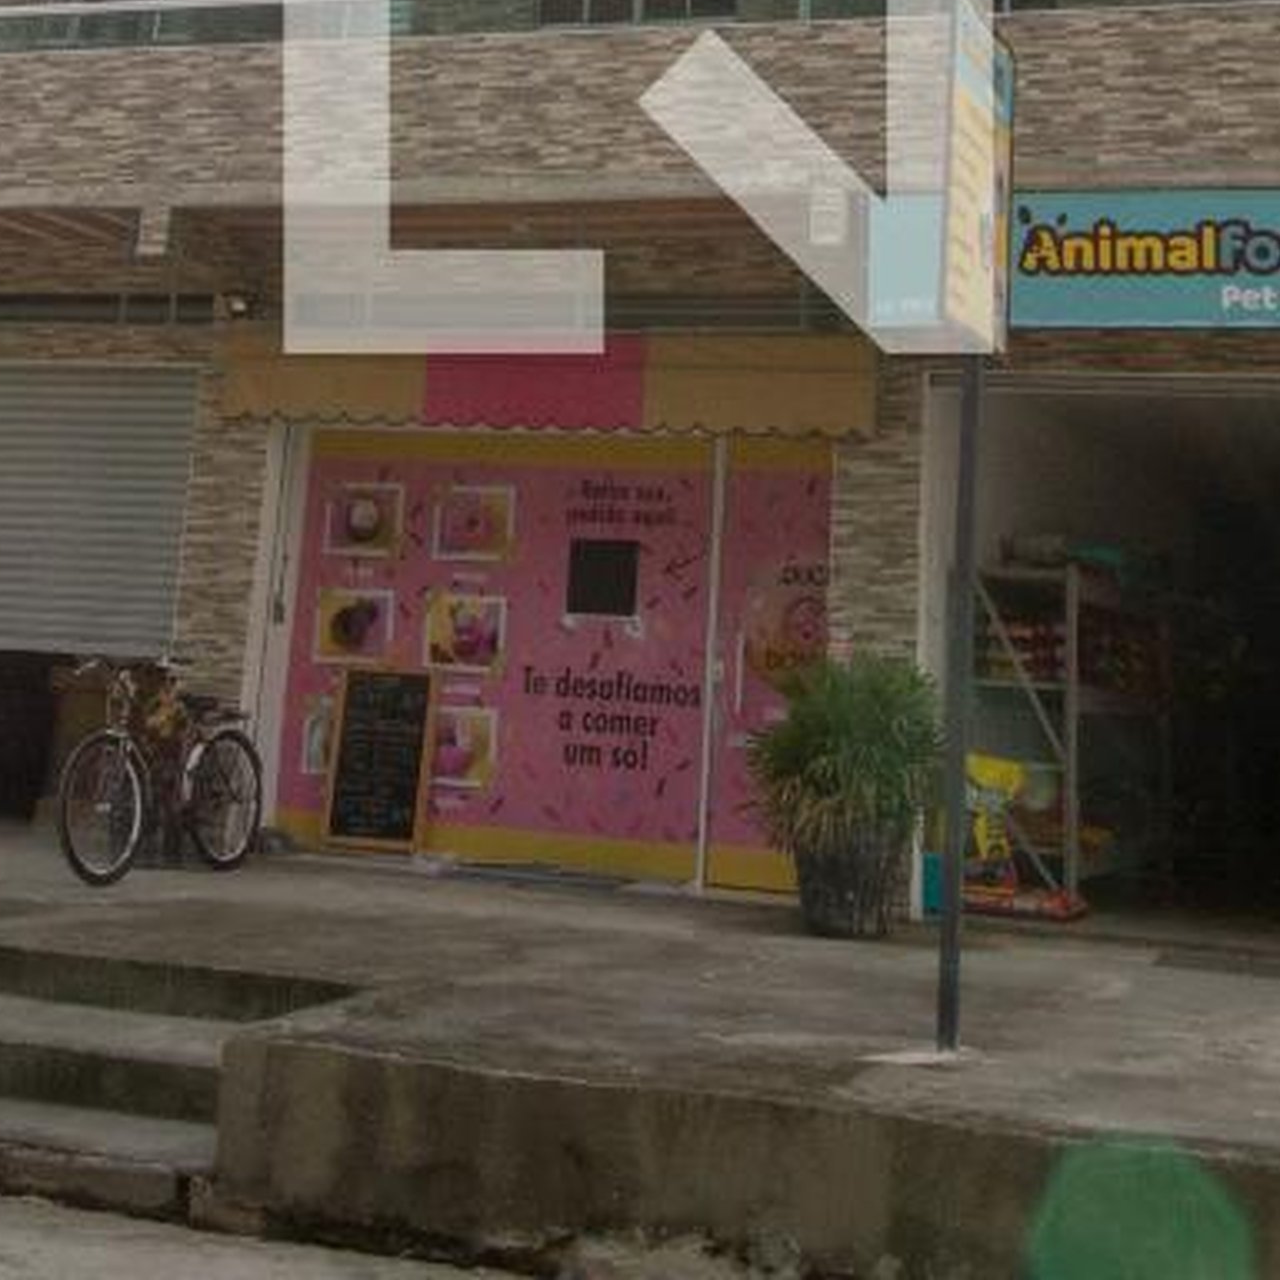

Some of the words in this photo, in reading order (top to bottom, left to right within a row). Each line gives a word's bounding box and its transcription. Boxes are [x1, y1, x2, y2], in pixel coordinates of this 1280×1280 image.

[1222, 286, 1276, 311] Pet
[525, 665, 549, 694] Te
[555, 666, 701, 706] desafiamos
[558, 710, 572, 731] a
[583, 711, 659, 737] comer
[565, 744, 601, 765] um
